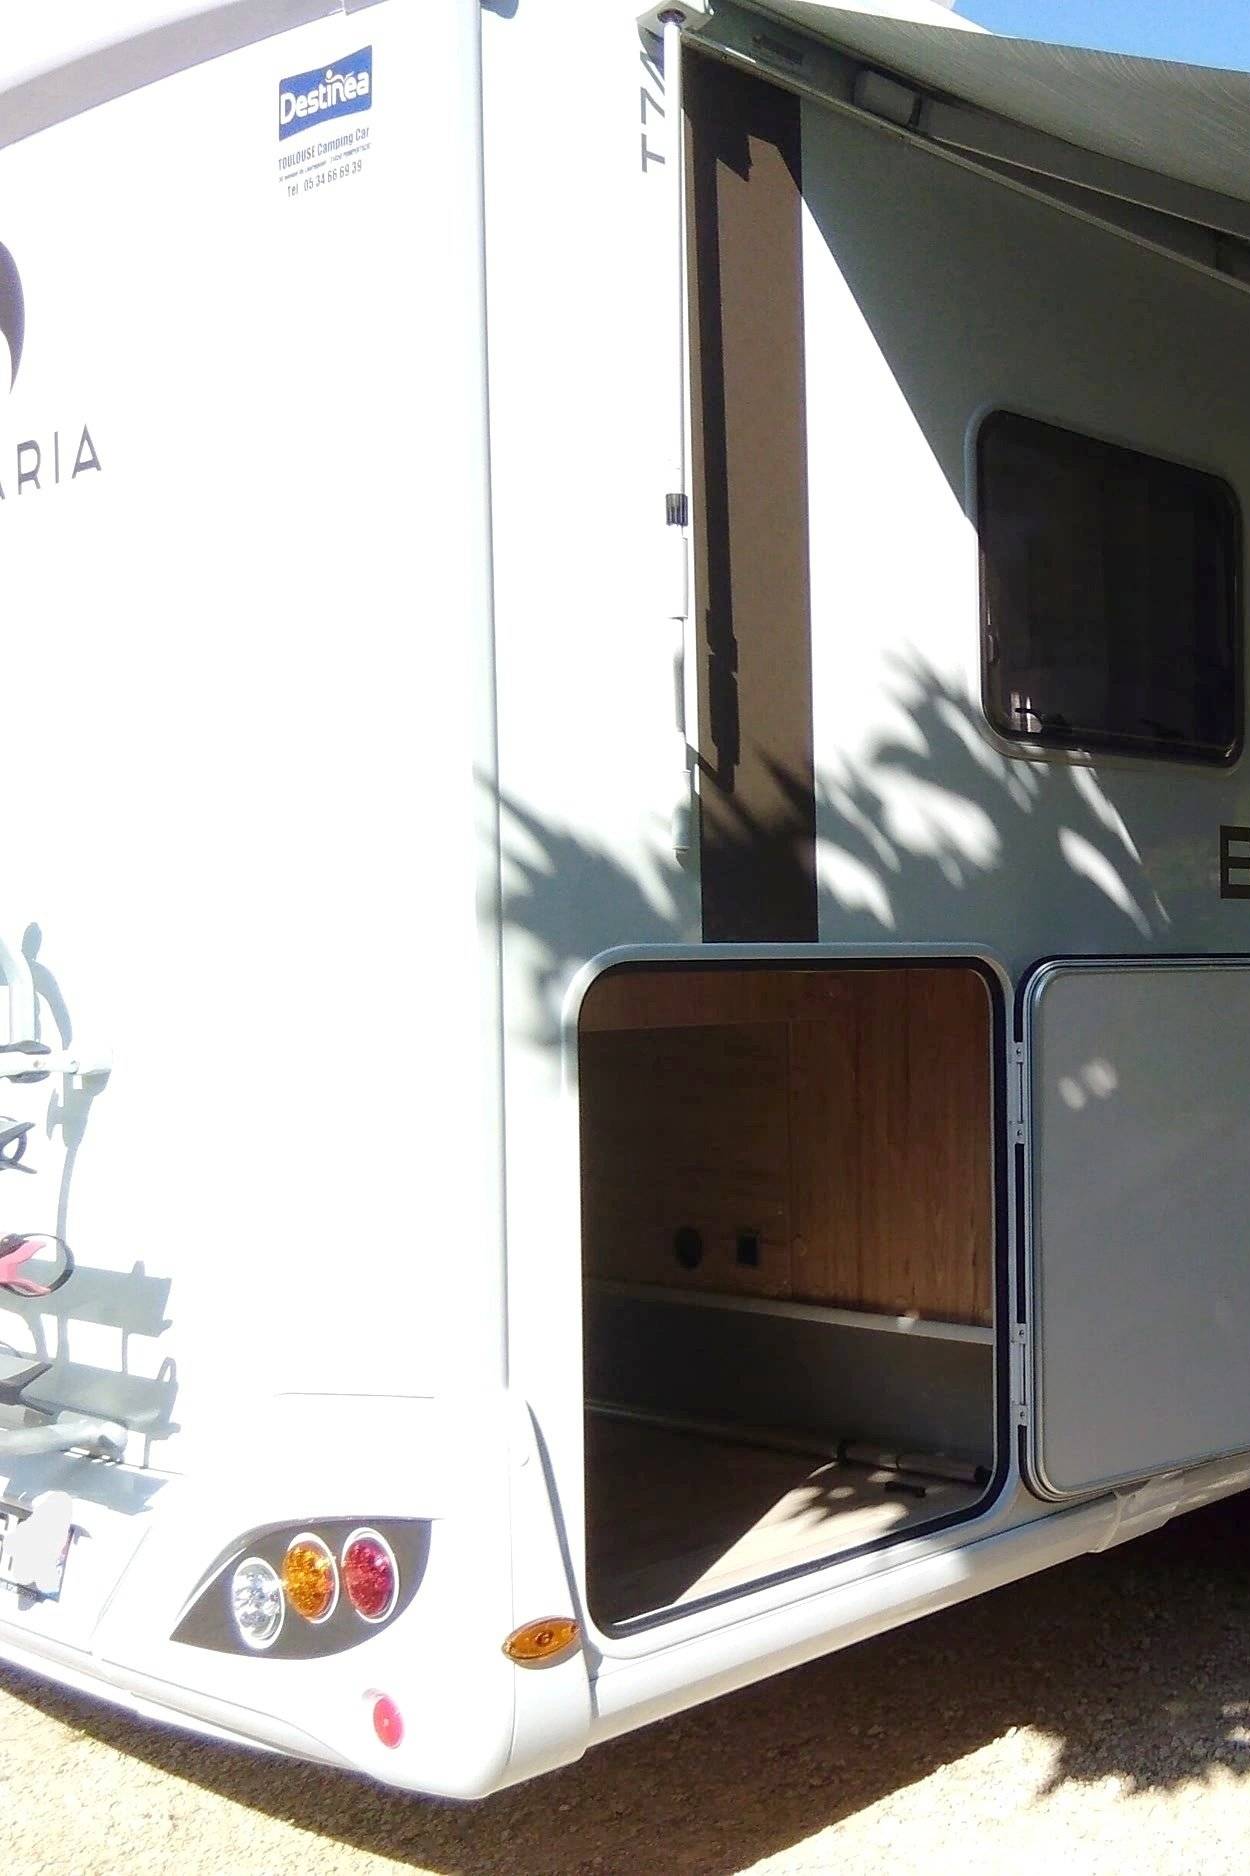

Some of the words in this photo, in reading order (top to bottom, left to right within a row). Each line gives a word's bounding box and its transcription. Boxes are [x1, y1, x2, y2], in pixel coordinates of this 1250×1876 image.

[278, 144, 316, 172] TOULOUSE
[317, 133, 354, 157] Camping
[355, 126, 370, 142] Car
[303, 177, 314, 192] 05
[315, 172, 326, 188] 34
[351, 158, 363, 175] 39
[0, 424, 101, 499] RIA
